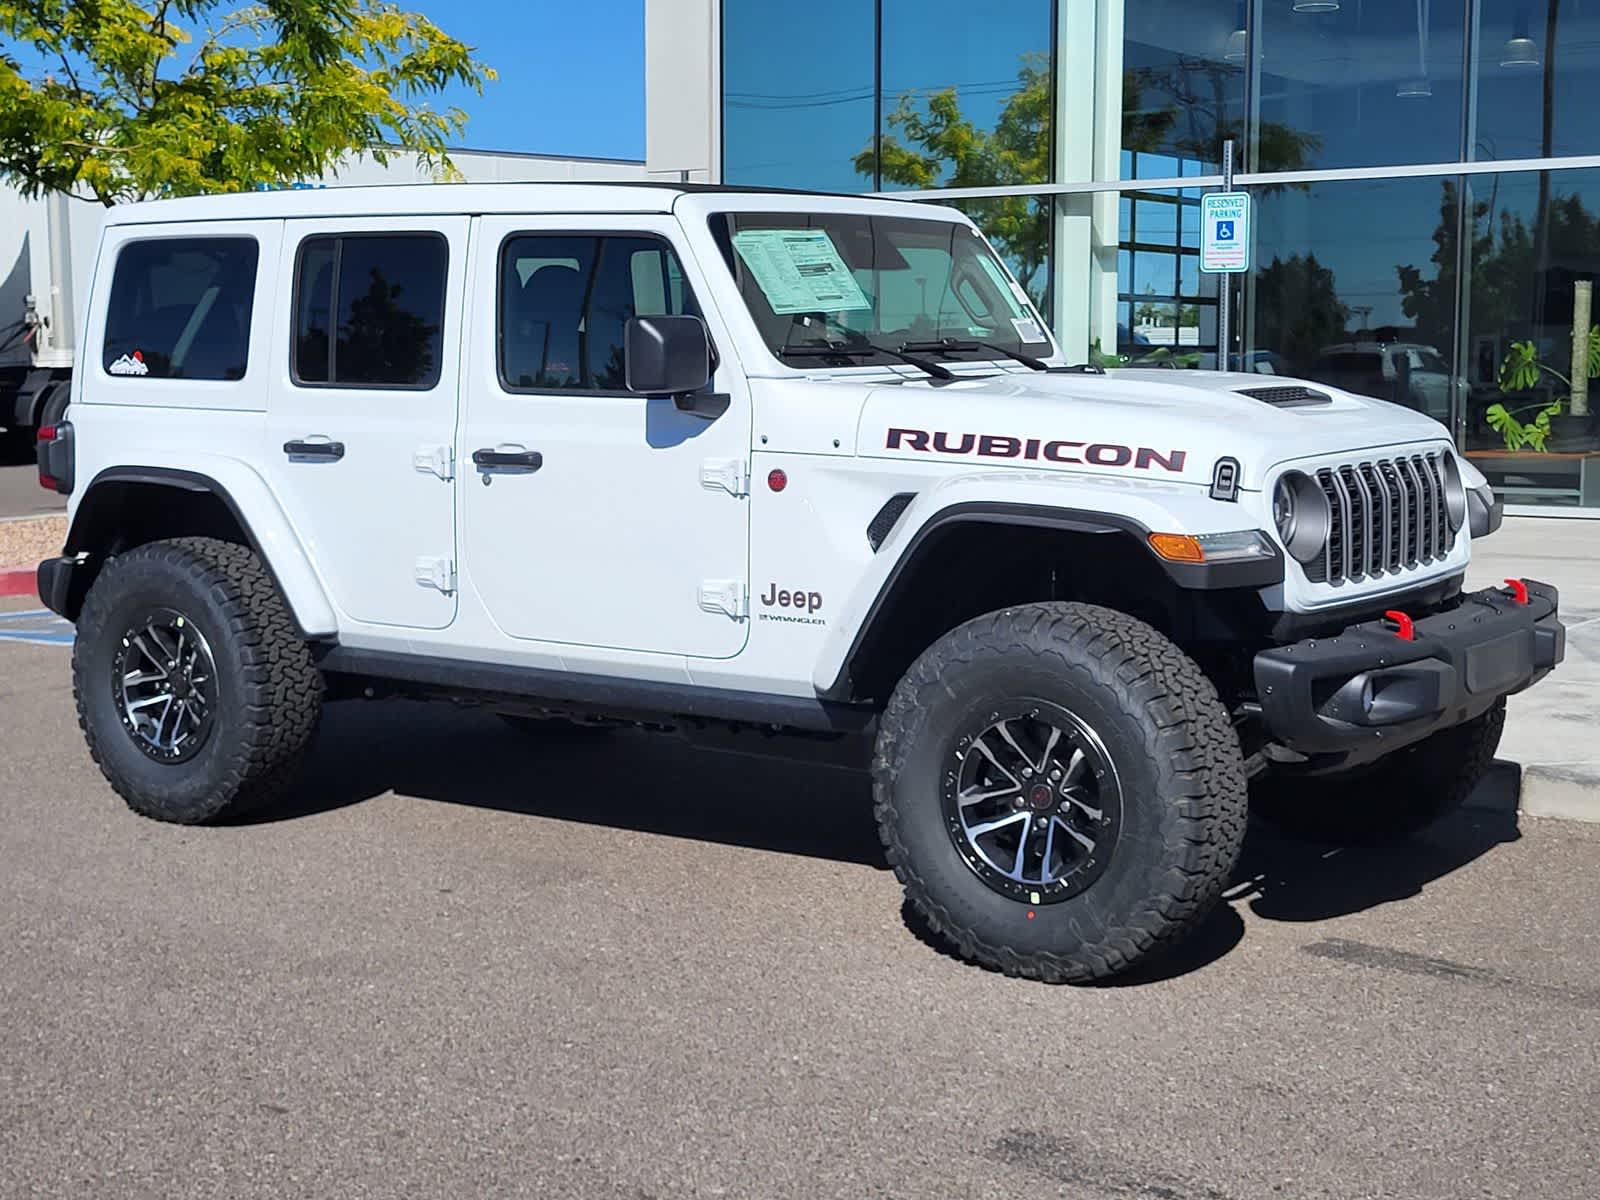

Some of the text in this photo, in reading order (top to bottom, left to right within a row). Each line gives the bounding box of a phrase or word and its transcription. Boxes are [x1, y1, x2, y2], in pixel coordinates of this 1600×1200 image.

[1208, 198, 1244, 209] RESERVED
[1209, 209, 1242, 218] PARKING
[886, 427, 1187, 472] RUBICON
[761, 582, 823, 614] Jeep
[769, 614, 826, 625] WRANGLER
